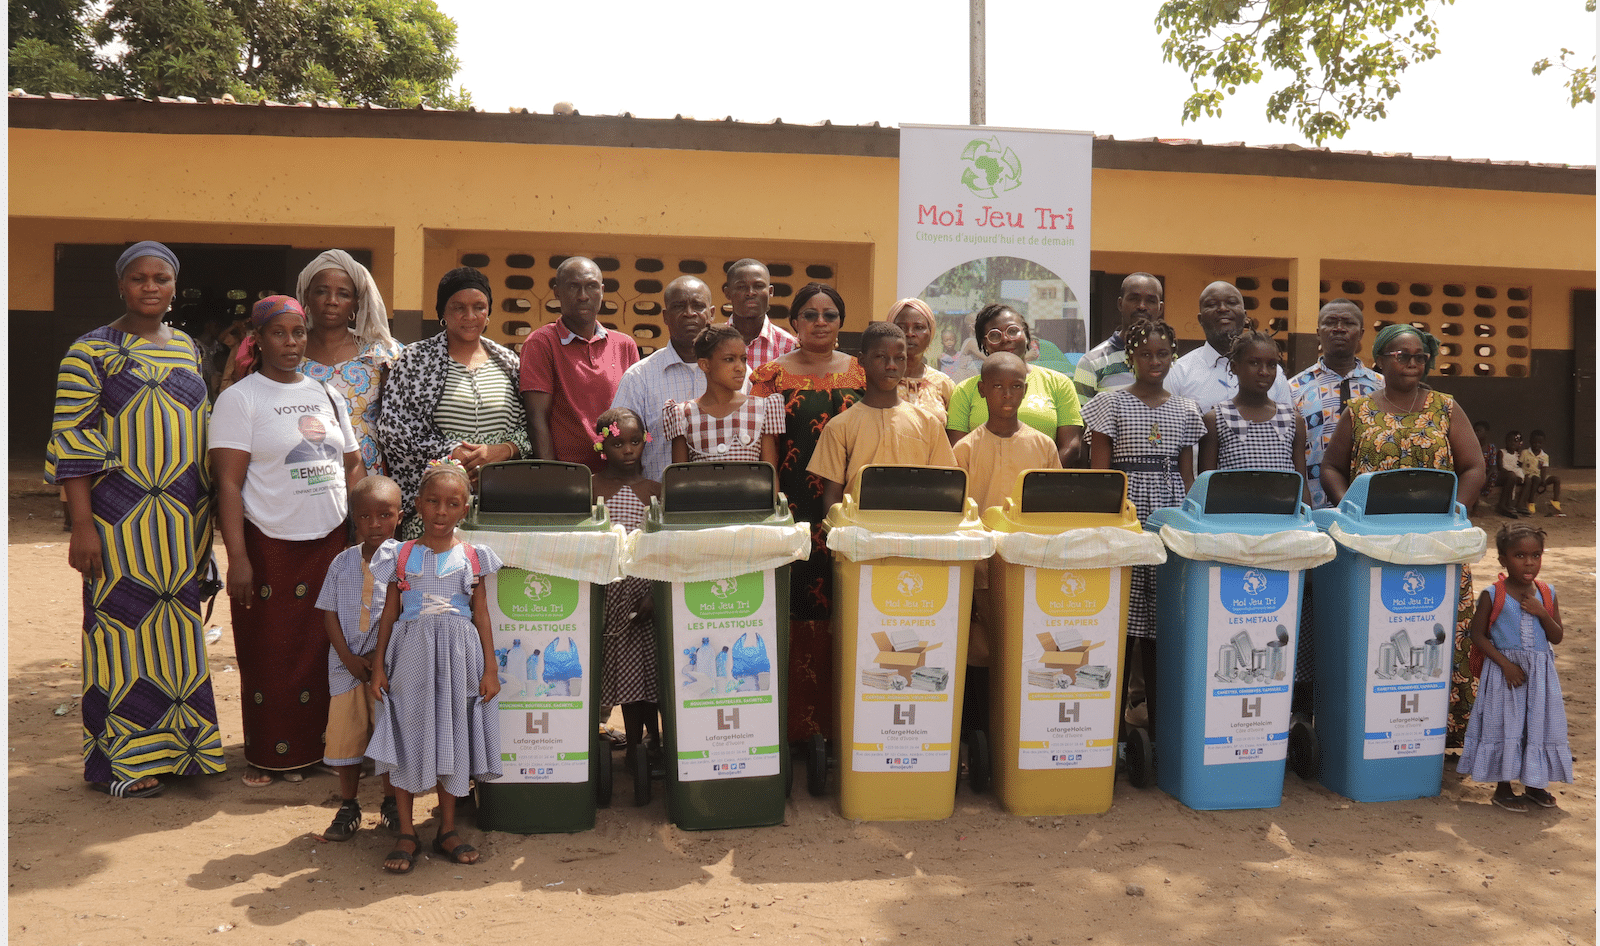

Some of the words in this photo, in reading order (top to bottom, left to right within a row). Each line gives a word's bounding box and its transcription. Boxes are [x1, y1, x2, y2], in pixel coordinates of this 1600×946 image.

[917, 203, 964, 226] Moi
[975, 206, 1024, 228] Jeu
[1034, 207, 1074, 230] Tri
[916, 230, 953, 244] Citoyens
[955, 232, 1015, 246] d'aujourd'hui
[1017, 236, 1025, 245] et
[1028, 235, 1039, 246] de
[1041, 236, 1075, 247] demain
[274, 405, 321, 415] VOTONS
[700, 602, 715, 611] Moi
[718, 602, 734, 610] Jeu
[736, 600, 750, 609] Tri
[885, 599, 900, 607] Moi
[921, 600, 934, 608] Tri
[1066, 600, 1081, 608] Jeu
[1085, 600, 1096, 608] Tri
[1233, 598, 1246, 606] Moi
[1249, 598, 1263, 606] Jeu
[1265, 597, 1276, 605] Tri
[512, 604, 528, 612] Moi
[531, 604, 547, 612] Jeu
[550, 604, 563, 612] Tri
[881, 619, 897, 627] LES
[900, 619, 936, 627] PAPIERS
[1046, 619, 1061, 627] LES
[1246, 615, 1279, 624] METAUX
[519, 624, 576, 632] PLASTIQUES
[688, 622, 704, 630] LES
[707, 619, 763, 629] PLASTIQUES
[706, 733, 754, 741] LafargeHolcim
